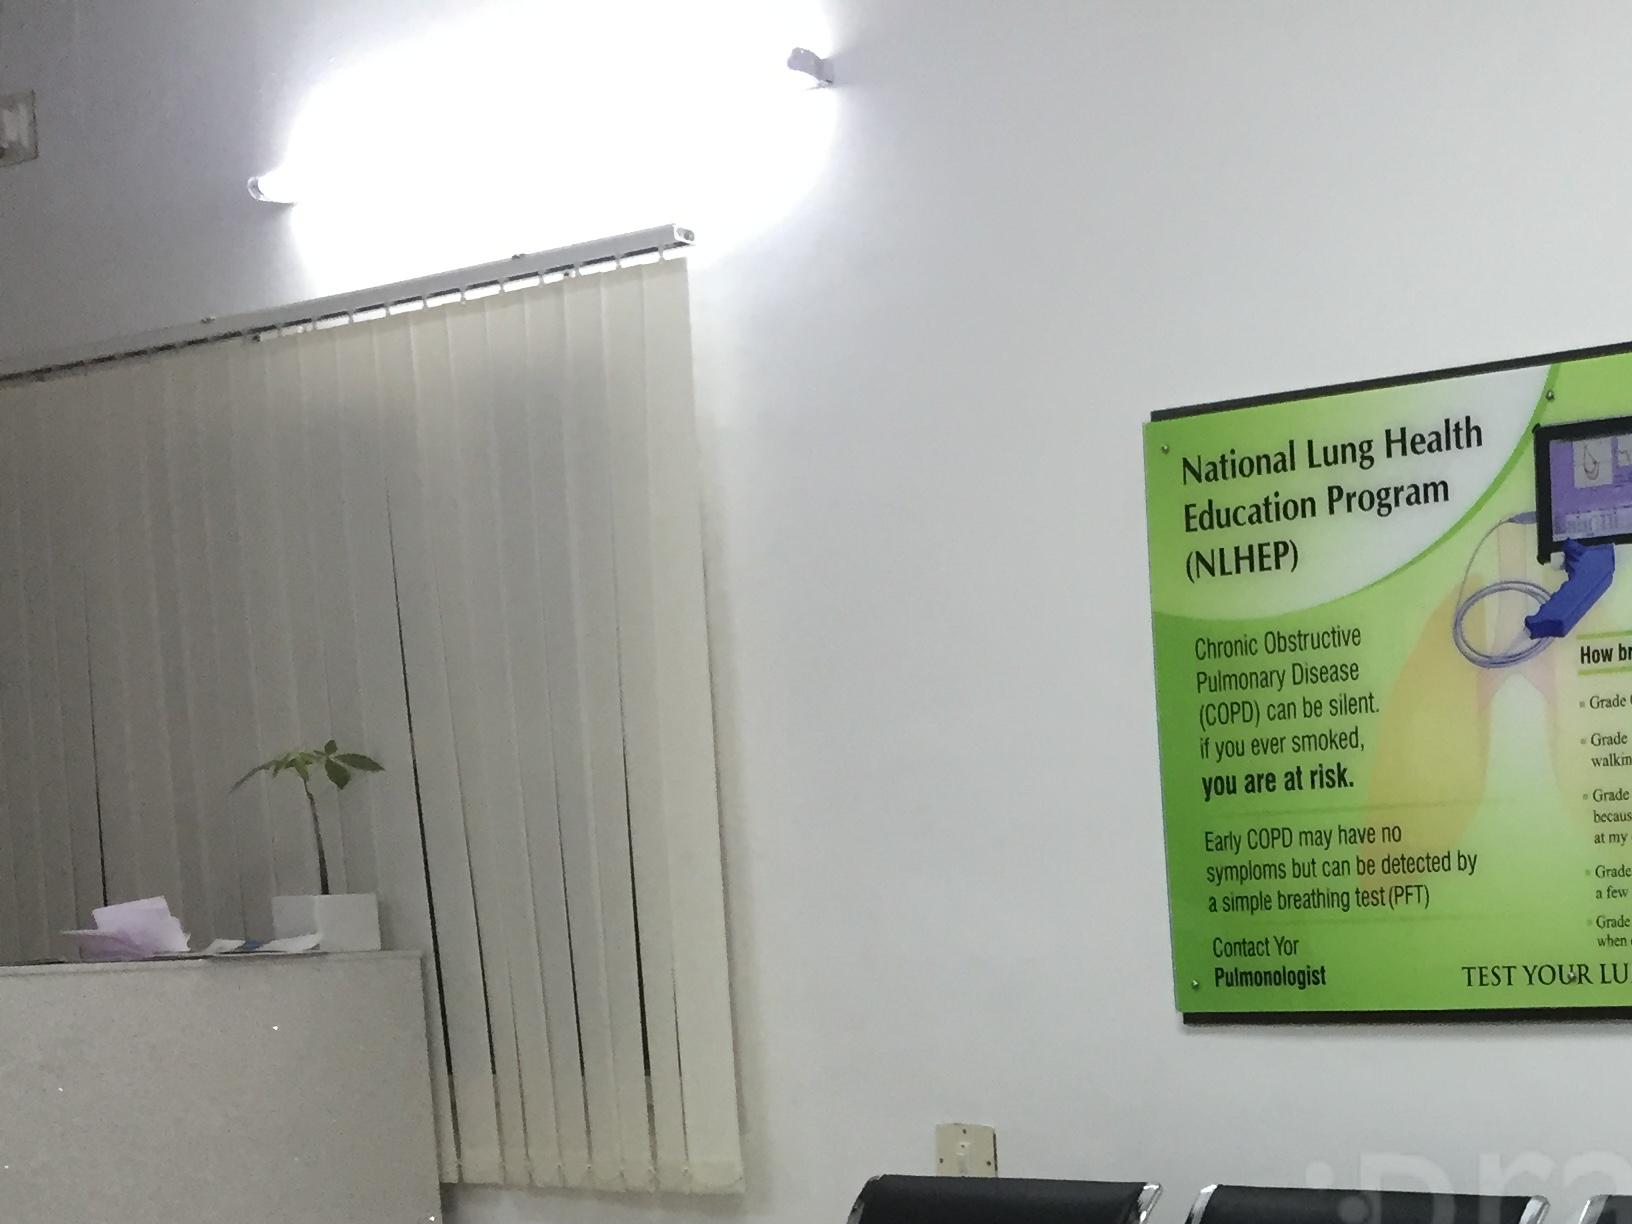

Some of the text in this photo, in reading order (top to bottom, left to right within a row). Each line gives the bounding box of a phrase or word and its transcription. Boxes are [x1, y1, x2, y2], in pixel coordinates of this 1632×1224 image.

[1182, 415, 1481, 484] National Lung Health
[1184, 480, 1448, 532] Education Program
[1186, 539, 1297, 583] (NLHEP)
[1195, 625, 1360, 659] Chronic Obstructive
[1580, 645, 1612, 663] How
[1197, 662, 1358, 693] Pulmonary Disease
[1200, 692, 1378, 731] (COPD) can be silent.
[1589, 693, 1626, 708] Grade
[1200, 725, 1363, 762] if you ever smoked,
[1590, 731, 1627, 746] Grade
[1202, 762, 1353, 801] you are at risk.
[1592, 787, 1629, 802] Grade
[1205, 824, 1401, 854] Early COPD may have no
[1594, 833, 1604, 843] at
[1609, 833, 1628, 845] my
[1292, 858, 1316, 878] but
[1322, 860, 1349, 876] can
[1356, 855, 1375, 875] be
[1381, 850, 1450, 874] detected
[1457, 850, 1477, 875] by
[1595, 864, 1631, 877] Grade
[1209, 896, 1217, 911] a
[1222, 890, 1271, 914] simple
[1277, 888, 1350, 911] breathing
[1596, 890, 1602, 898] a
[1606, 885, 1627, 898] few
[1213, 936, 1298, 957] Contact Yor
[1215, 965, 1325, 989] Pulmonologist
[1461, 965, 1516, 986] TEST
[1522, 963, 1593, 984] YOUR
